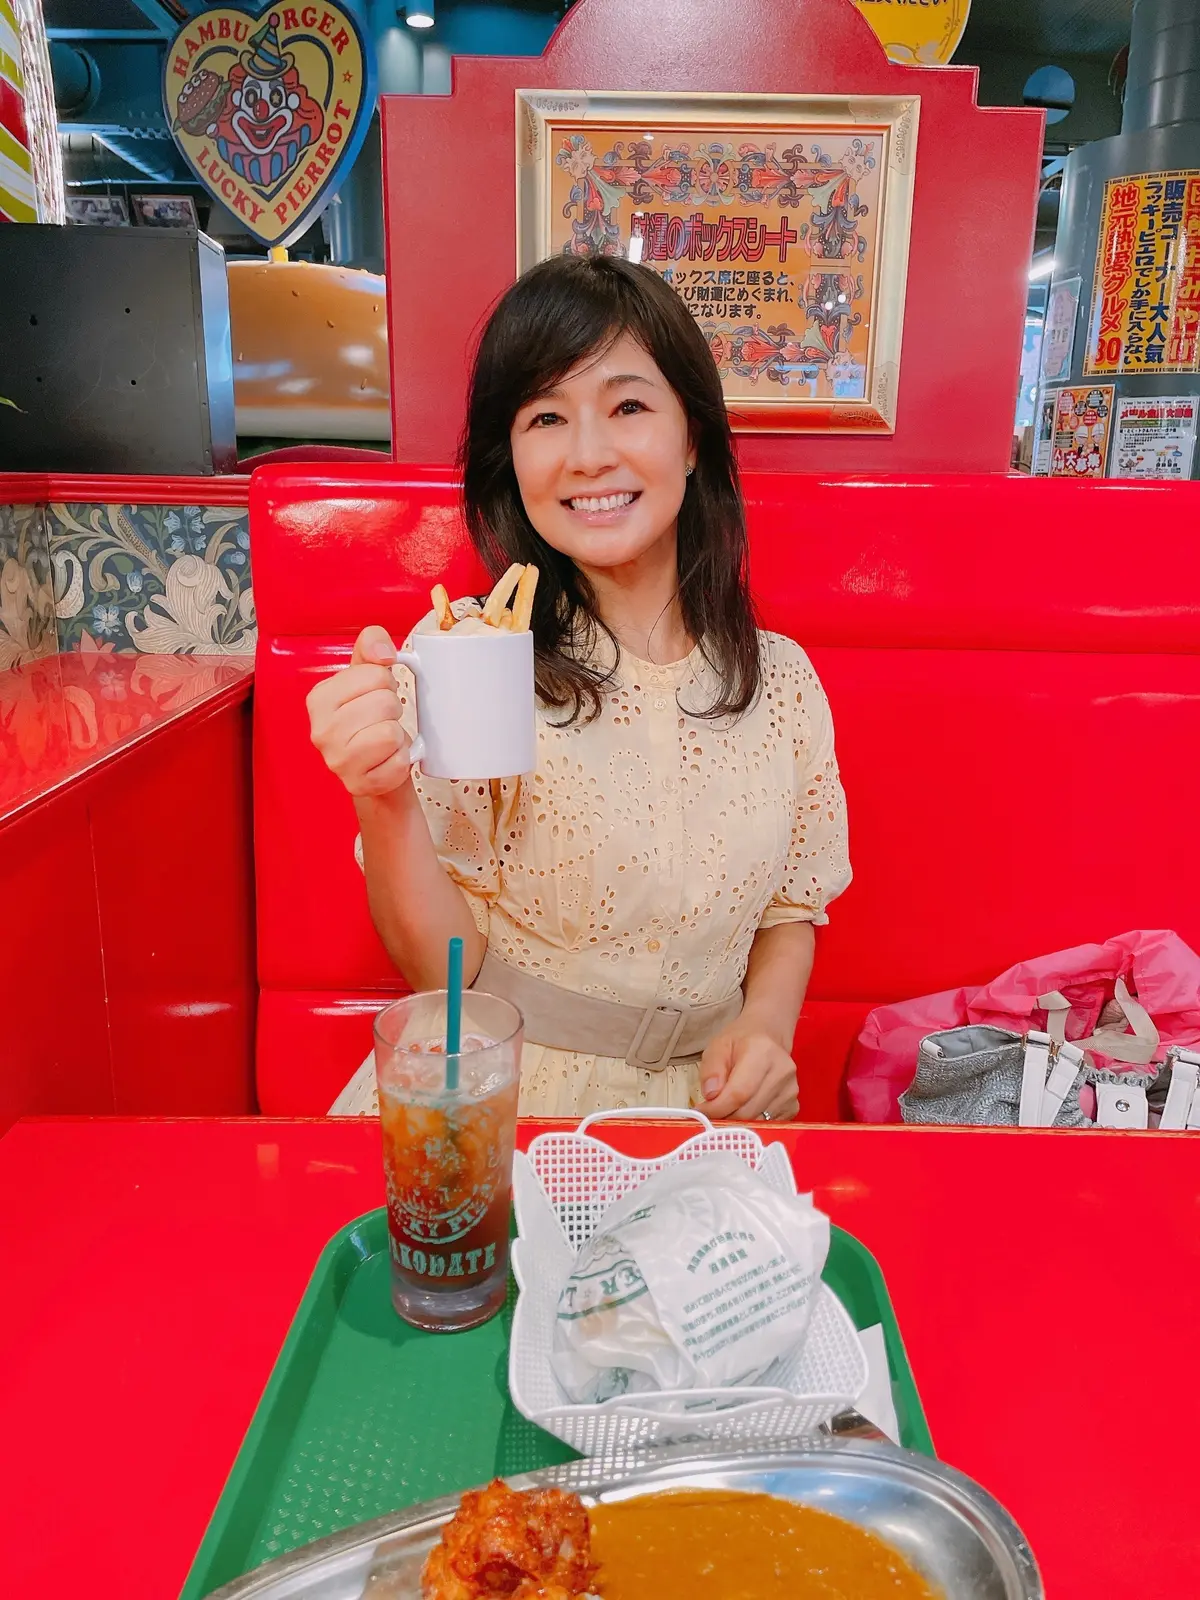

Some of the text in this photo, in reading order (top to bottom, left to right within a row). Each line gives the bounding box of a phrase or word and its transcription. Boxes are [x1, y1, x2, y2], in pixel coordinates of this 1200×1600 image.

[196, 98, 351, 226] LUCKY PIERROT
[1123, 181, 1163, 365] ラッキーピエロでしか手に入らない
[1144, 179, 1187, 364] 販売コーナー大人気
